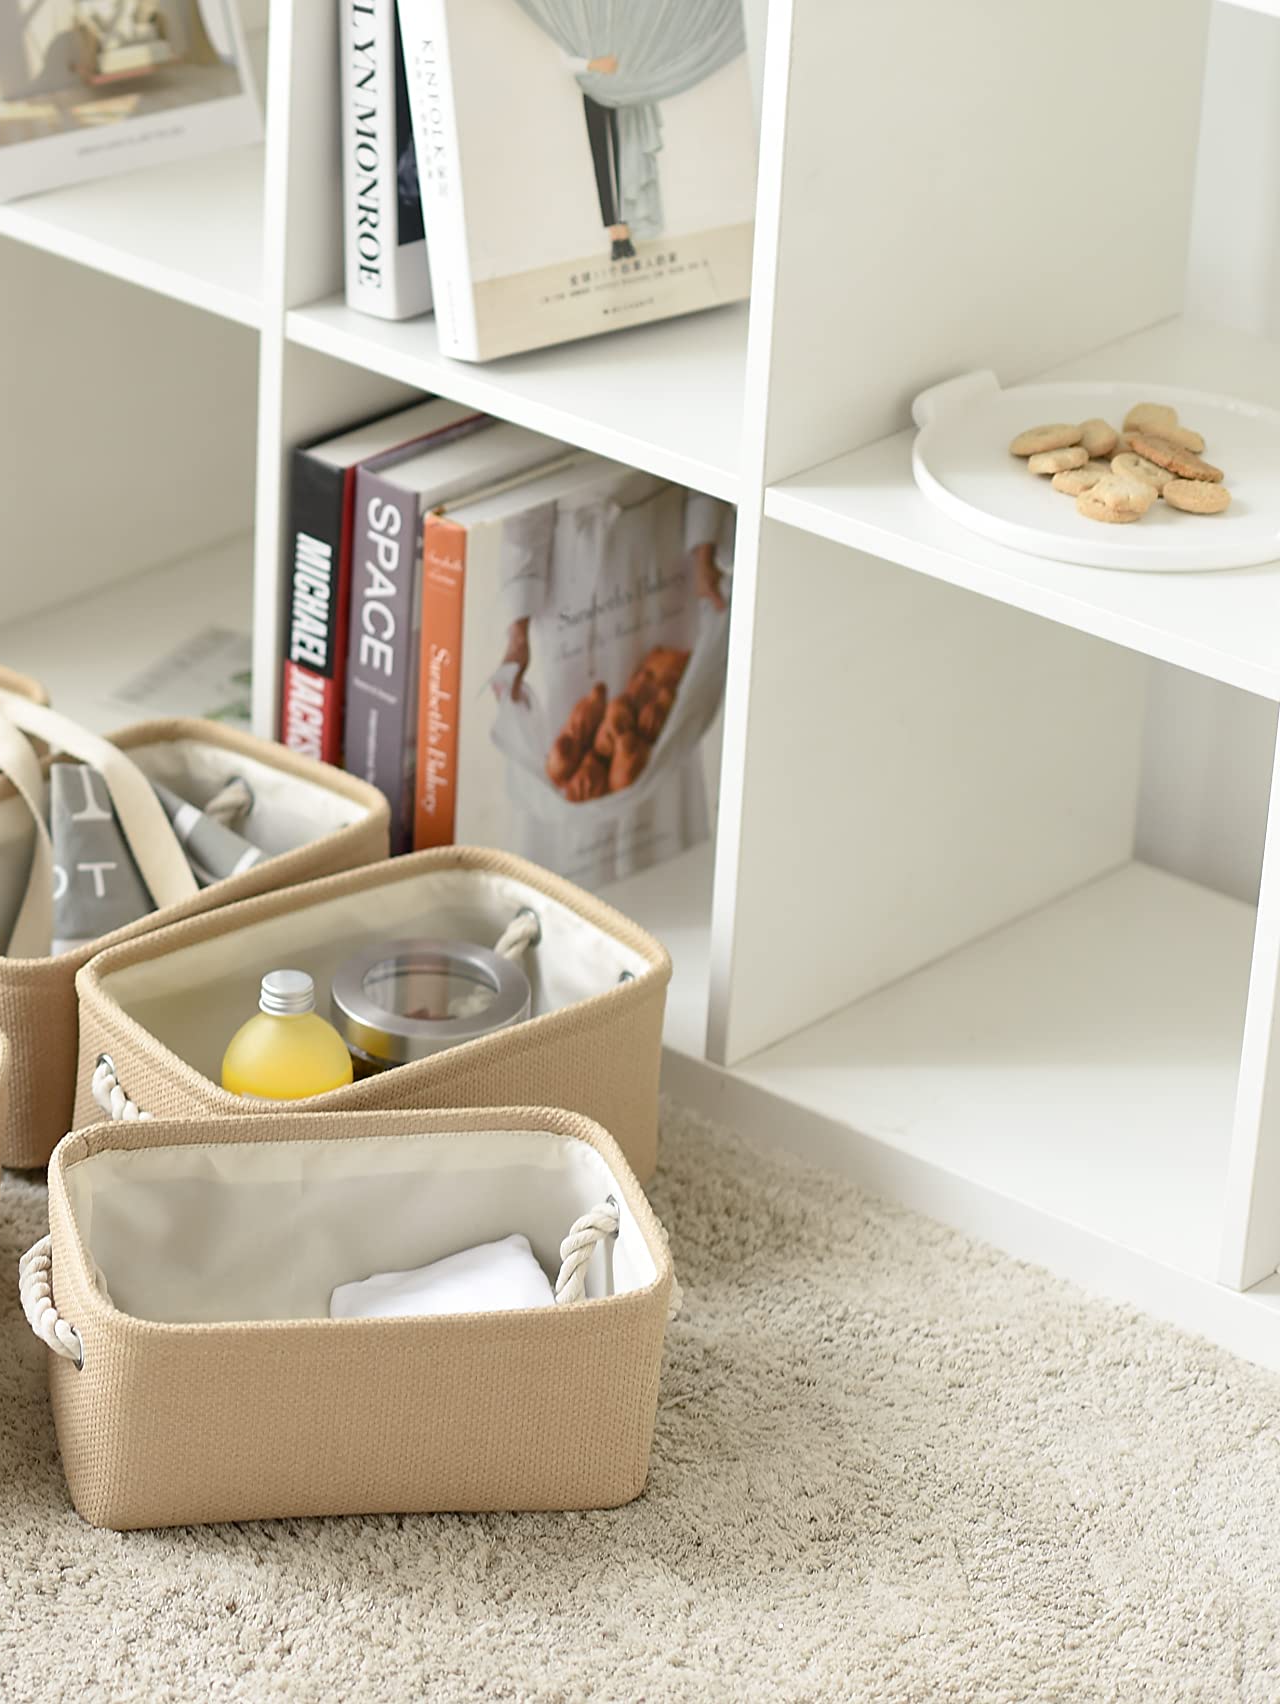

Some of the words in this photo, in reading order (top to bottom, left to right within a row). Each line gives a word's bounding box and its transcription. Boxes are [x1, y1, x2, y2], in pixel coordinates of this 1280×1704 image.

[422, 40, 447, 163] KINFOLK
[354, 101, 381, 290] MONROE
[290, 532, 333, 668] MICHAEL
[360, 496, 402, 676] SPACE
